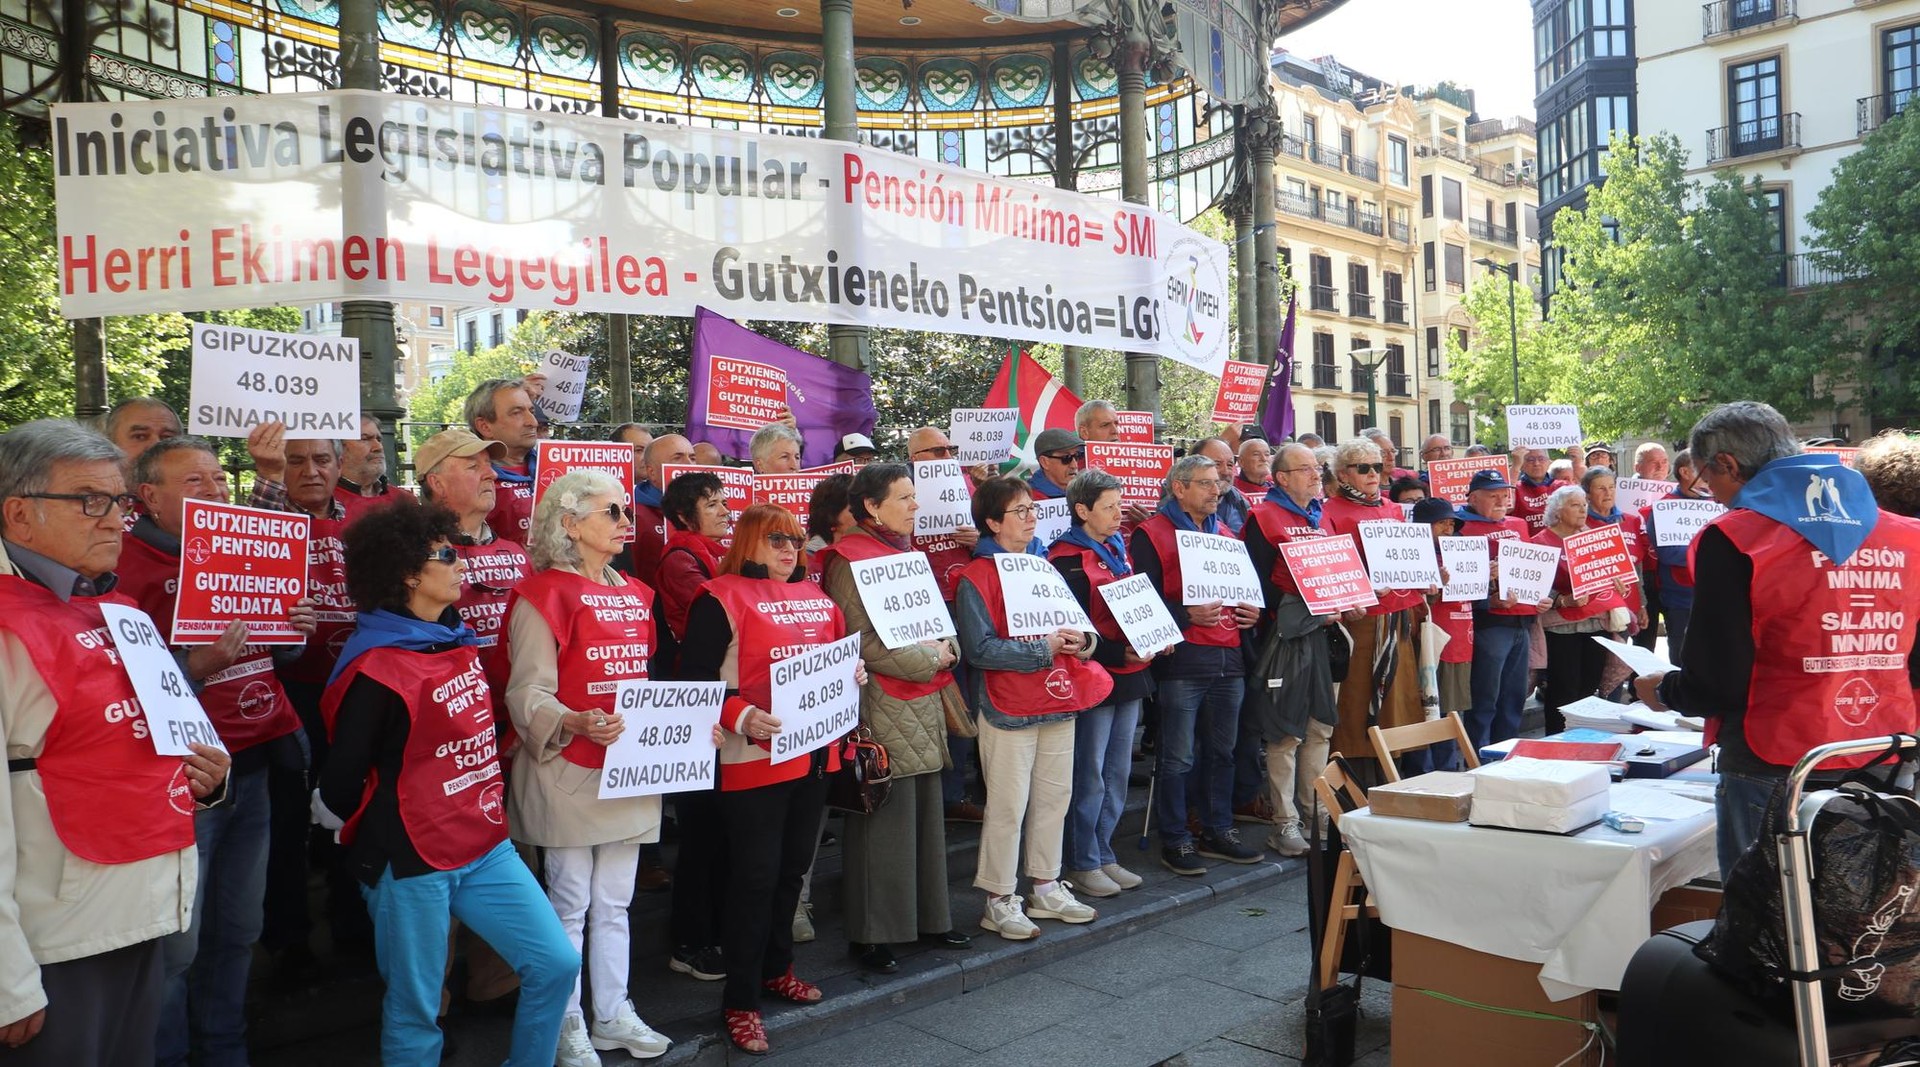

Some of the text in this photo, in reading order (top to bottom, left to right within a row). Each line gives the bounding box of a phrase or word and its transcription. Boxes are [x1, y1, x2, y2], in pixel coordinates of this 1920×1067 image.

[57, 106, 301, 177] Iniciativa
[318, 104, 605, 185] Legislativa
[623, 133, 807, 211] Popular
[844, 152, 964, 227] Pensión
[1113, 210, 1157, 260] SMI
[63, 229, 192, 295] Herri
[212, 224, 406, 288] Ekimen
[428, 233, 668, 306] Legegilea
[712, 249, 949, 319] Gutxieneko
[1167, 275, 1187, 308] EHPM
[1195, 289, 1219, 319] MPEH
[200, 329, 353, 362] GIPUZKOAN
[717, 361, 785, 383] GUTXIENEKO
[236, 371, 318, 396] 48.039
[730, 374, 781, 392] PENTSIOA
[718, 391, 785, 409] GUTXIENEKO
[198, 404, 355, 431] SINADURAK
[729, 404, 778, 420] SOLDATA
[954, 411, 1017, 422] GIPUZKOAN
[1509, 407, 1575, 416] GIPUZKOAN
[1526, 421, 1562, 431] 48.039
[969, 431, 1003, 442] 48.039
[1511, 436, 1579, 447] SINADURAK
[548, 447, 632, 463] GUTXIENEKO
[1092, 445, 1172, 459] GUTXIENEKO
[1106, 457, 1162, 469] PENTSIOA
[1434, 458, 1506, 472] GUTXIENEKO
[769, 492, 811, 504] PENTS
[193, 508, 308, 541] GUTXIENEKO
[1362, 526, 1431, 539] GIPUZKOAN
[211, 535, 291, 560] PENTSIOA
[1181, 534, 1247, 556] GIPUZKOAN
[1441, 540, 1487, 552] GIPUZKOAN
[1567, 527, 1621, 550] GUTXIENEKO
[1287, 539, 1353, 557] GUTXIENEKO
[1385, 548, 1421, 560] 48.039
[1501, 545, 1556, 563] GIPUZKOA
[1575, 540, 1616, 557] PENTSIOA
[1302, 552, 1351, 568] PENTSIOA
[1573, 553, 1627, 575] GUTXIENEKO
[1811, 546, 1905, 569] PNSIÓN
[860, 559, 931, 586] GIPUZKOA
[1203, 560, 1241, 576] 48.039
[1455, 561, 1478, 573] 48.039
[1508, 568, 1542, 582] 48.039
[1580, 566, 1621, 583] SOLDATA
[195, 572, 301, 595] GUTXIENEKO
[1302, 569, 1363, 588] GUTXIENEKO
[1373, 571, 1439, 584] SINADURAK
[1826, 566, 1902, 590] MÍNIMA
[1187, 584, 1263, 602] SINADURAK
[1314, 583, 1360, 599] SOLDATA
[1444, 582, 1488, 596] SINADURAK
[210, 596, 284, 616] SOLDATA
[757, 598, 835, 614] GUTXIENEKO
[884, 589, 931, 614] 48.039
[771, 611, 832, 625] PENTSIOA
[1123, 604, 1154, 625] 48.039
[1821, 611, 1904, 631] SALARIO
[177, 621, 213, 631] PENSIÓN
[214, 621, 231, 631] MÍN
[890, 617, 944, 643] FIRMAS
[775, 637, 860, 686] GIPUZKOAN
[621, 687, 723, 709] GIPUZKOAN
[798, 679, 844, 711] 48.039
[638, 724, 692, 748] 48.039
[776, 703, 858, 755] SINADURAK
[607, 760, 711, 788] SINADURAK
